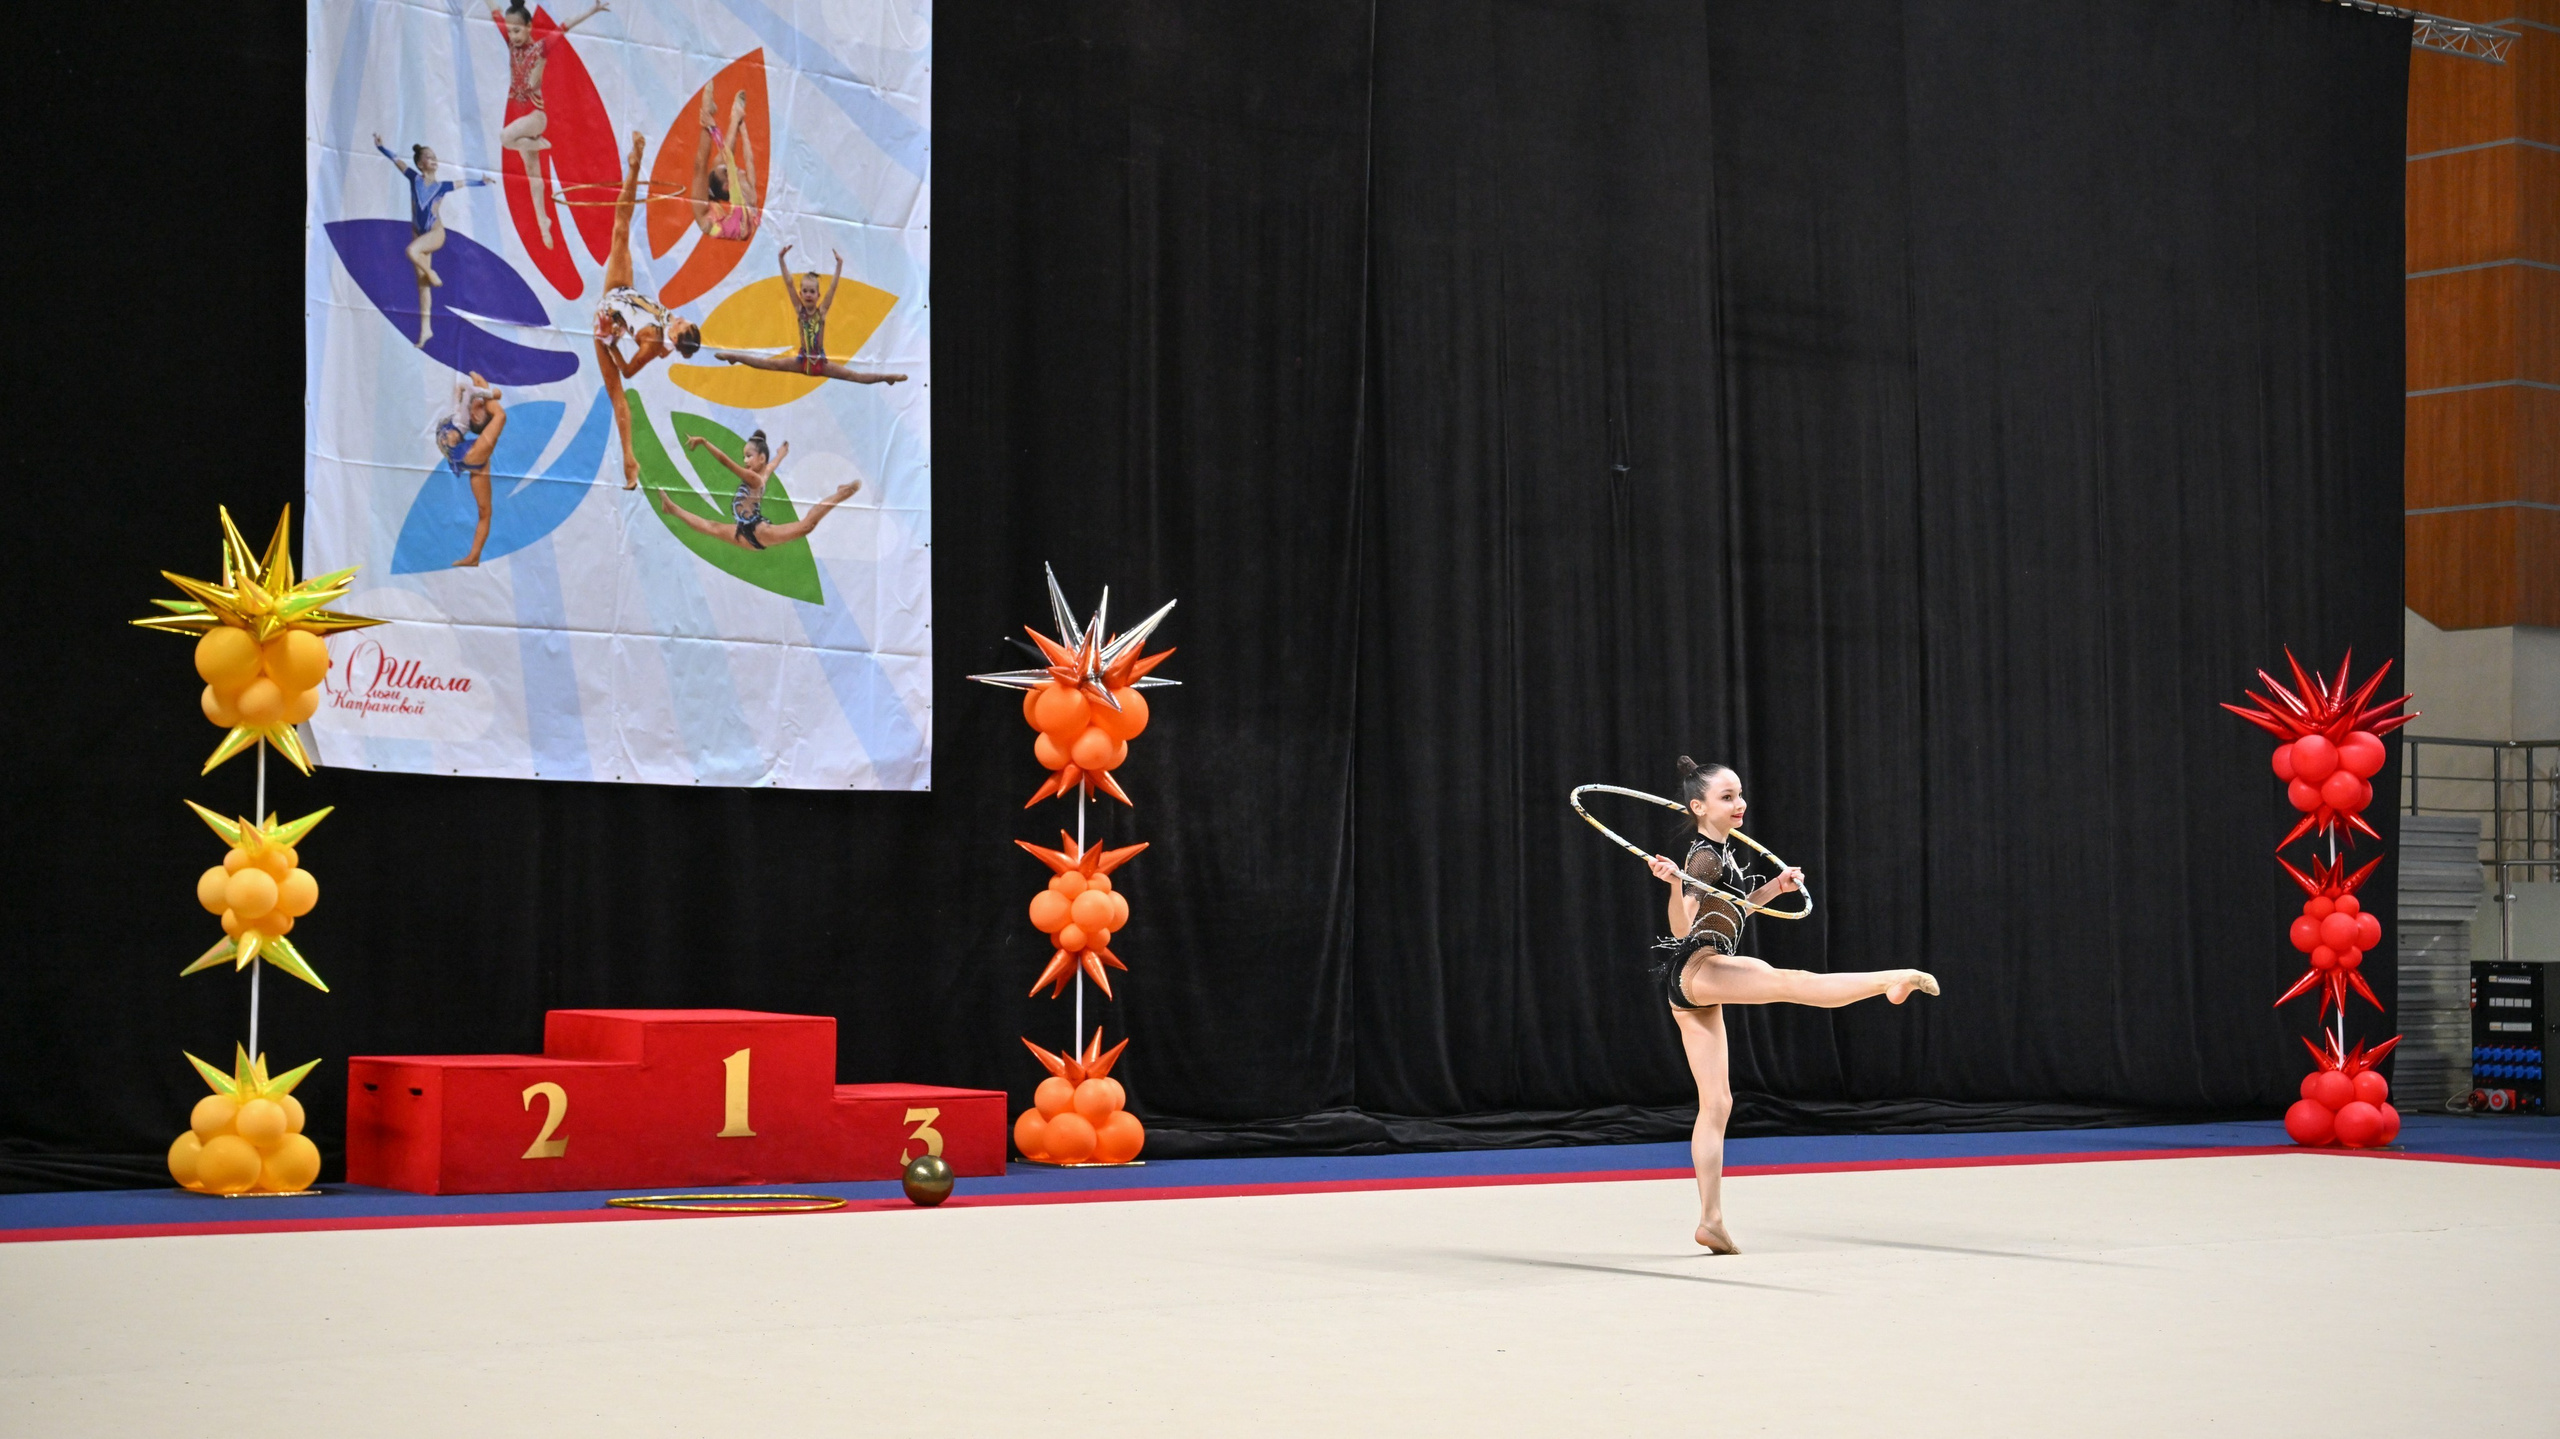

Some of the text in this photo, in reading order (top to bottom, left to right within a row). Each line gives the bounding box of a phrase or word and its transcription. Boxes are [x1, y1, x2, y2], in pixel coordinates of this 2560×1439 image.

[329, 689, 426, 719] Капрановой
[382, 656, 472, 693] Школа
[520, 1081, 570, 1159] 2
[716, 1047, 757, 1138] 1
[900, 1107, 944, 1167] 3
